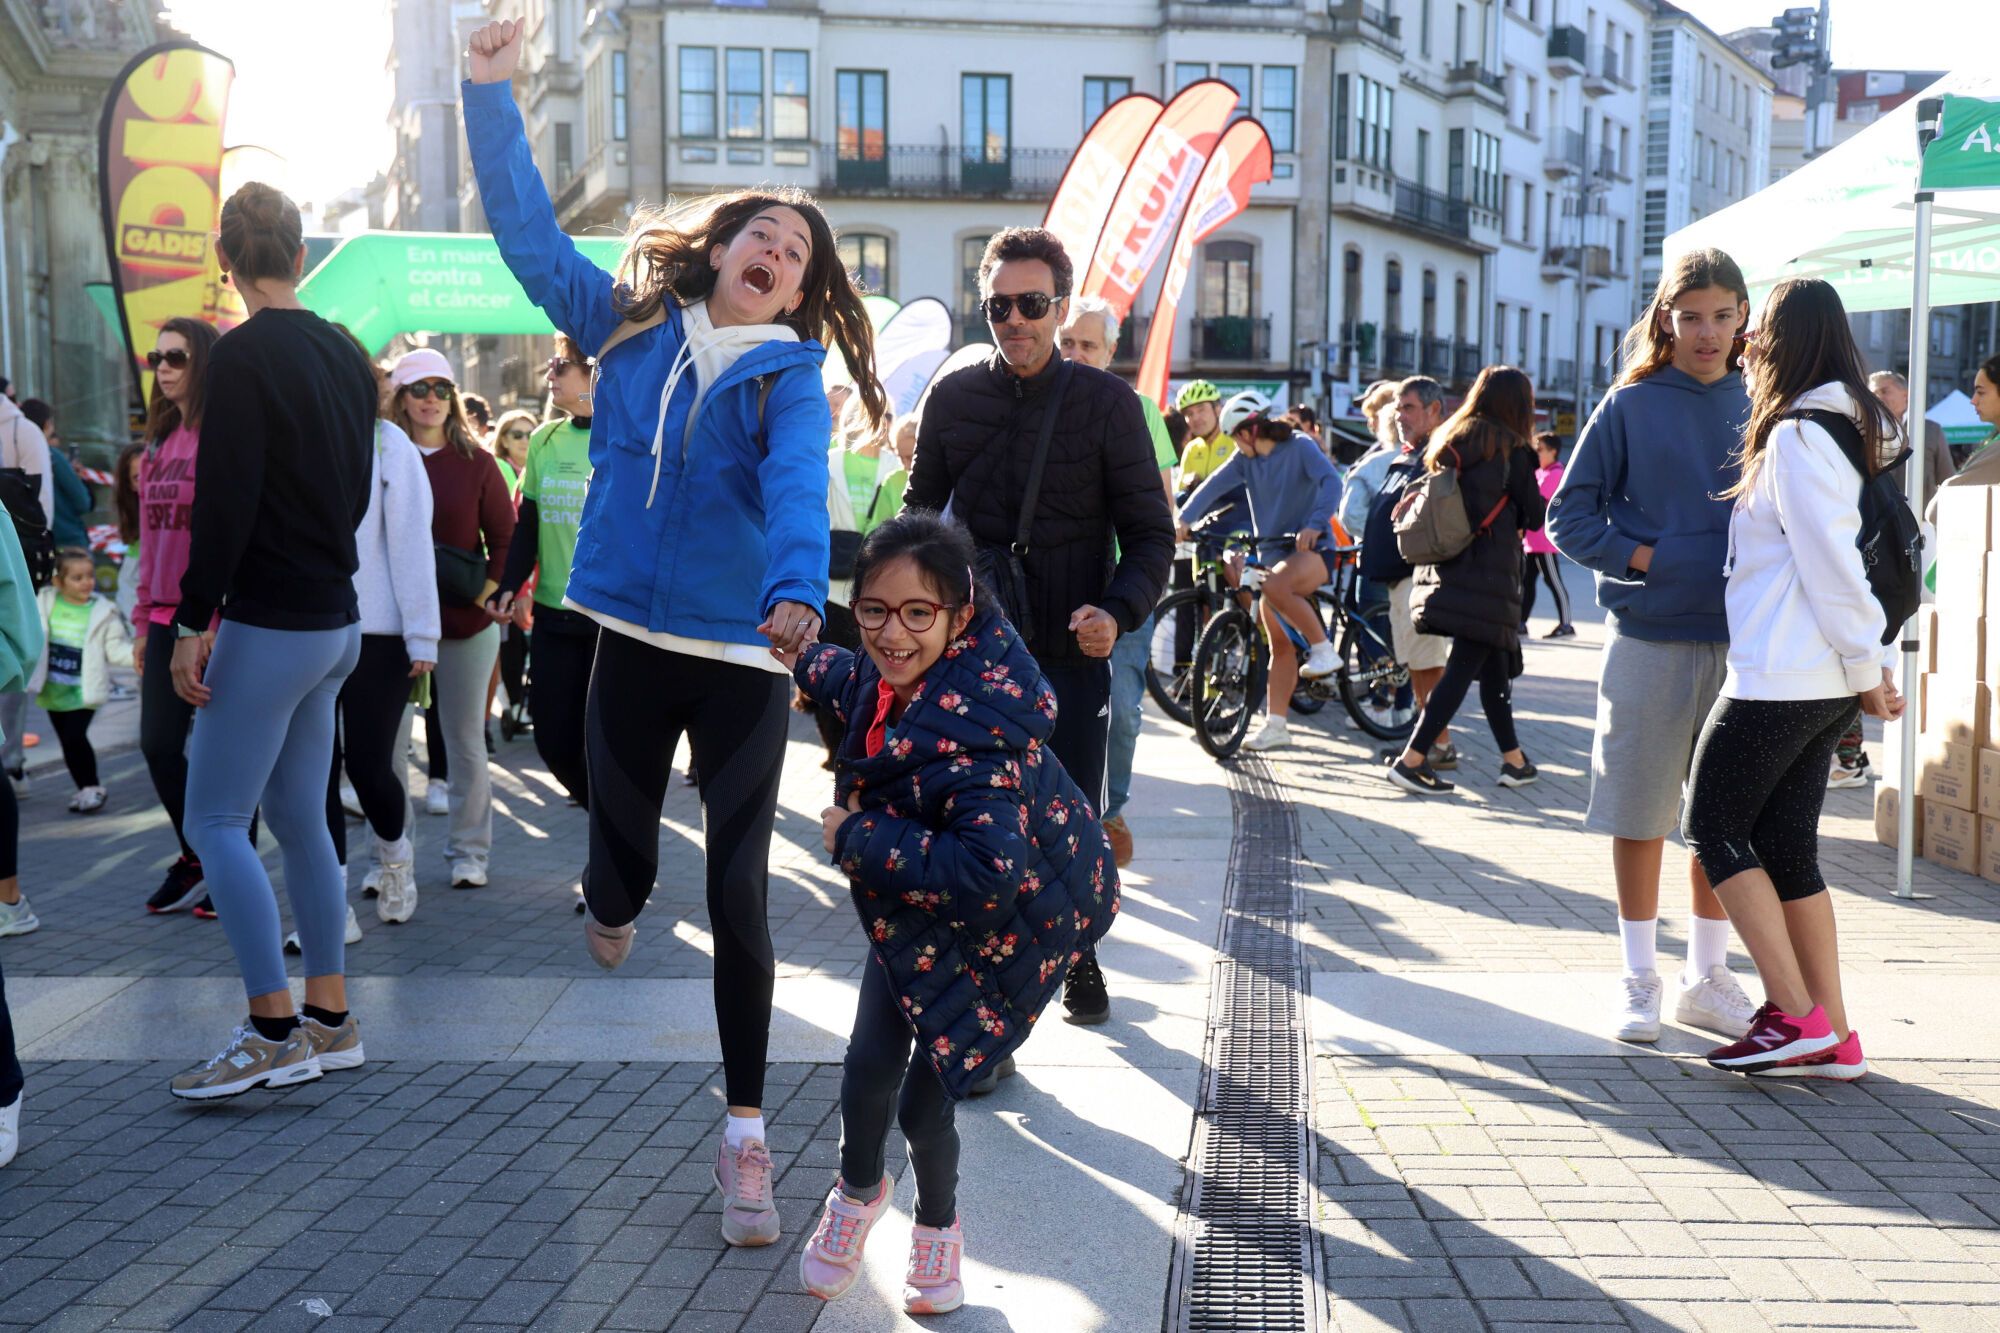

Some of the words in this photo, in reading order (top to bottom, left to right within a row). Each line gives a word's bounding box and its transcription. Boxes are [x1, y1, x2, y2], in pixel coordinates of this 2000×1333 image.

[1101, 134, 1188, 281] FROIZ
[113, 48, 226, 396] ADIS
[124, 227, 207, 258] GADIS
[407, 246, 436, 264] En
[443, 249, 500, 265] marc
[408, 268, 483, 286] contra
[408, 291, 431, 307] el
[435, 289, 513, 309] cáncer
[899, 372, 926, 413] alud
[146, 457, 194, 482] MIL
[148, 484, 179, 500] AND
[145, 503, 192, 530] EPEA
